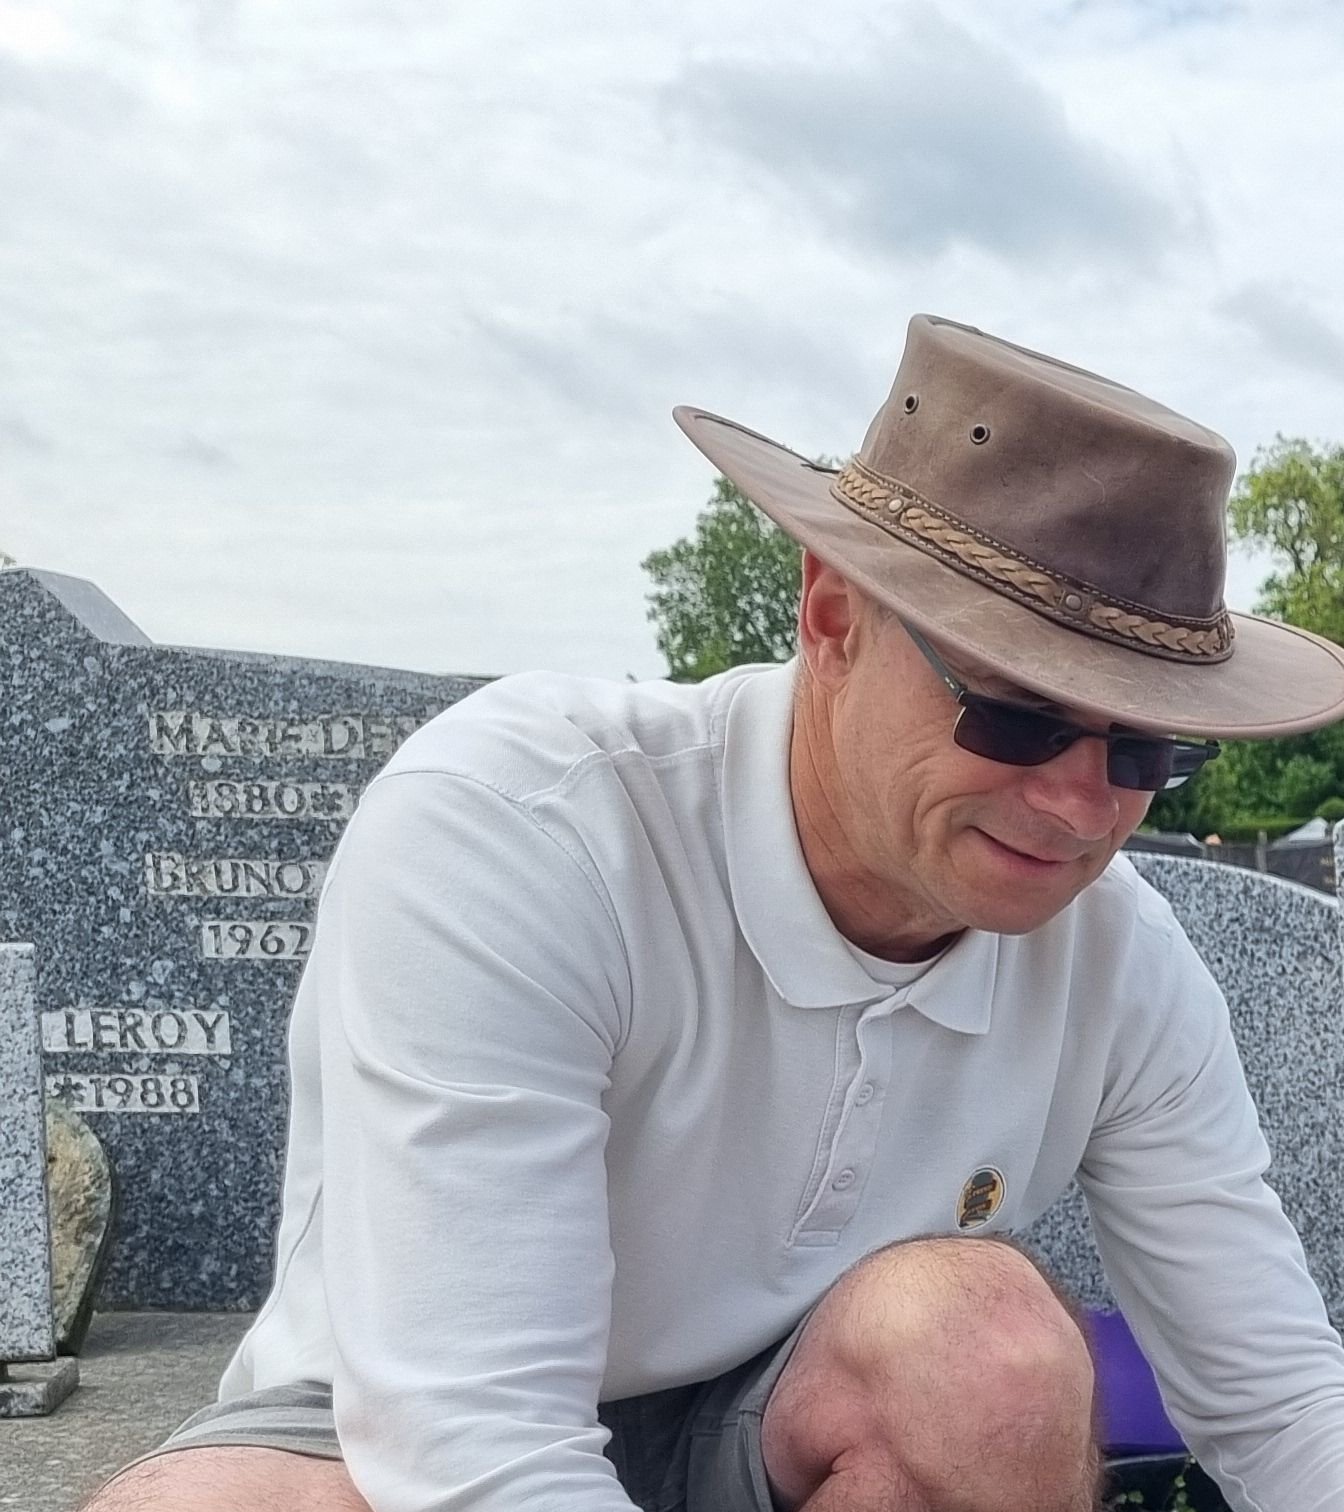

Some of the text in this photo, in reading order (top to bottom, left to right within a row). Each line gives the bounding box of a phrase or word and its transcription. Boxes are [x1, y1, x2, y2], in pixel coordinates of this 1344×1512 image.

[151, 852, 312, 896] BRUNO
[207, 923, 312, 957] 1962
[64, 1010, 224, 1050] LEROY
